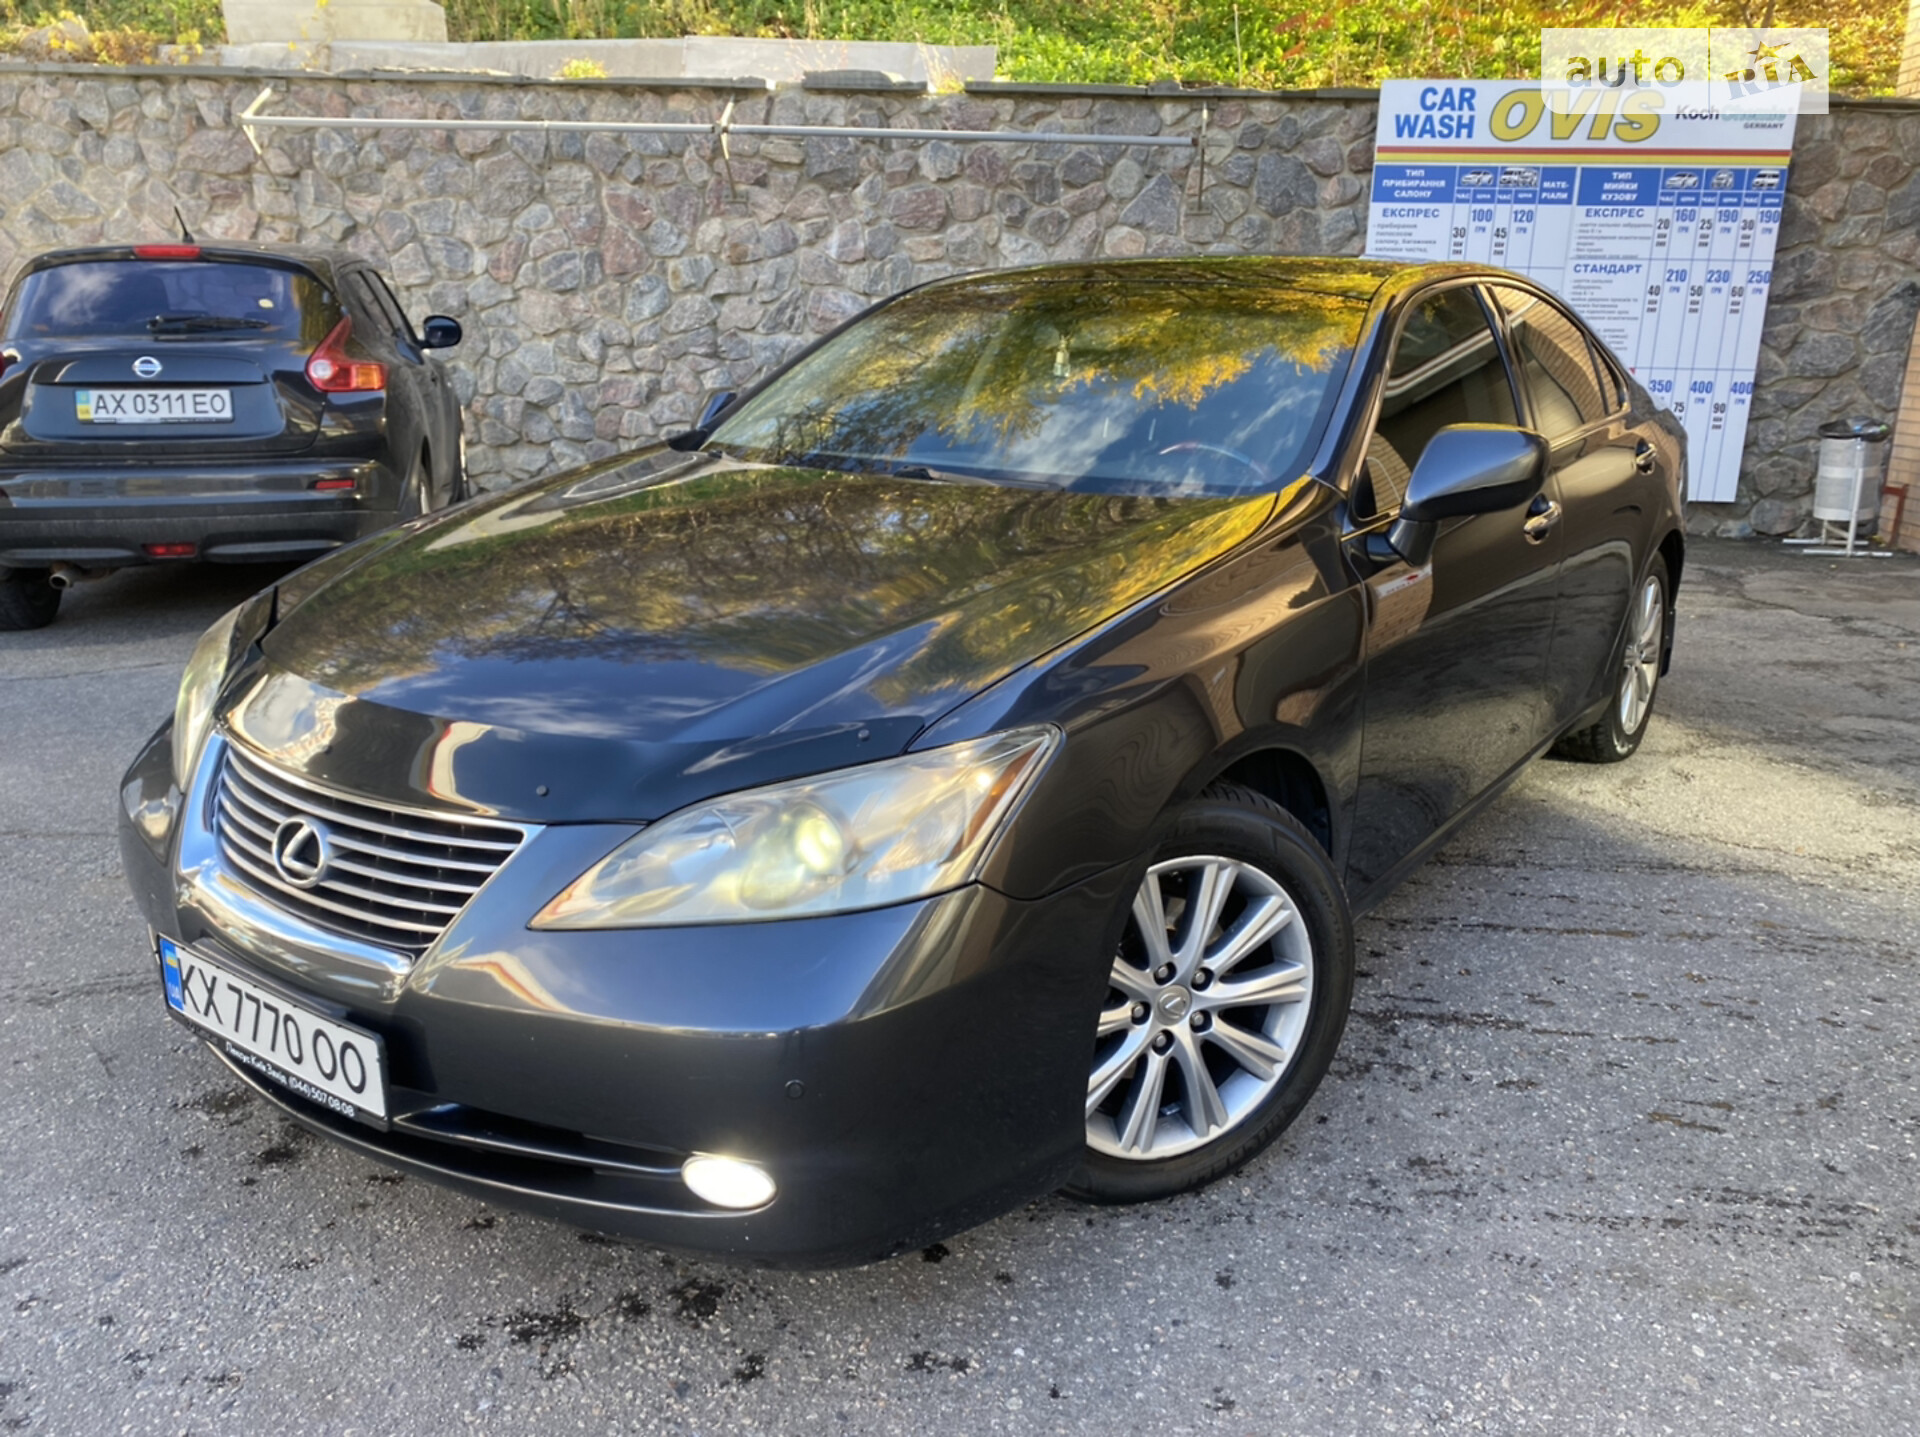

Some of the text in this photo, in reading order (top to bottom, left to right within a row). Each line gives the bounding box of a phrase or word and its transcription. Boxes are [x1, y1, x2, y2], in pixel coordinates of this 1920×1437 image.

[1419, 86, 1476, 111] CAR
[1395, 114, 1475, 139] WASH
[1405, 169, 1425, 178] ТИП
[1612, 171, 1632, 180] ТИП
[1394, 190, 1432, 198] САЛОНУ
[1382, 208, 1440, 218] ЕКСПРЕС
[1472, 208, 1493, 222] 100
[1513, 209, 1533, 223] 120
[1585, 208, 1645, 218] ЕКСПРЕС
[1675, 208, 1696, 222] 160
[1718, 209, 1738, 223] 190
[1759, 210, 1780, 224] 190
[1657, 218, 1670, 230] 20
[1699, 218, 1712, 231] 25
[1741, 219, 1754, 231] 30
[1452, 227, 1466, 239] 30
[1494, 227, 1507, 239] 45
[1573, 263, 1642, 275] СТАНДАРТ
[1666, 268, 1688, 282] 210
[1707, 269, 1730, 283] 230
[1748, 270, 1771, 284] 250
[1648, 285, 1660, 296] 40
[1690, 285, 1703, 297] 50
[1649, 380, 1672, 393] 350
[1690, 380, 1713, 394] 400
[1730, 382, 1753, 395] 400
[94, 393, 226, 414] AX 0311 EO
[1674, 402, 1685, 413] 75
[1713, 402, 1725, 414] 90
[178, 957, 223, 1026] KX
[227, 982, 304, 1066] 7770
[289, 1075, 310, 1097] (044)
[311, 1087, 327, 1103] 507
[328, 1097, 341, 1110] 08
